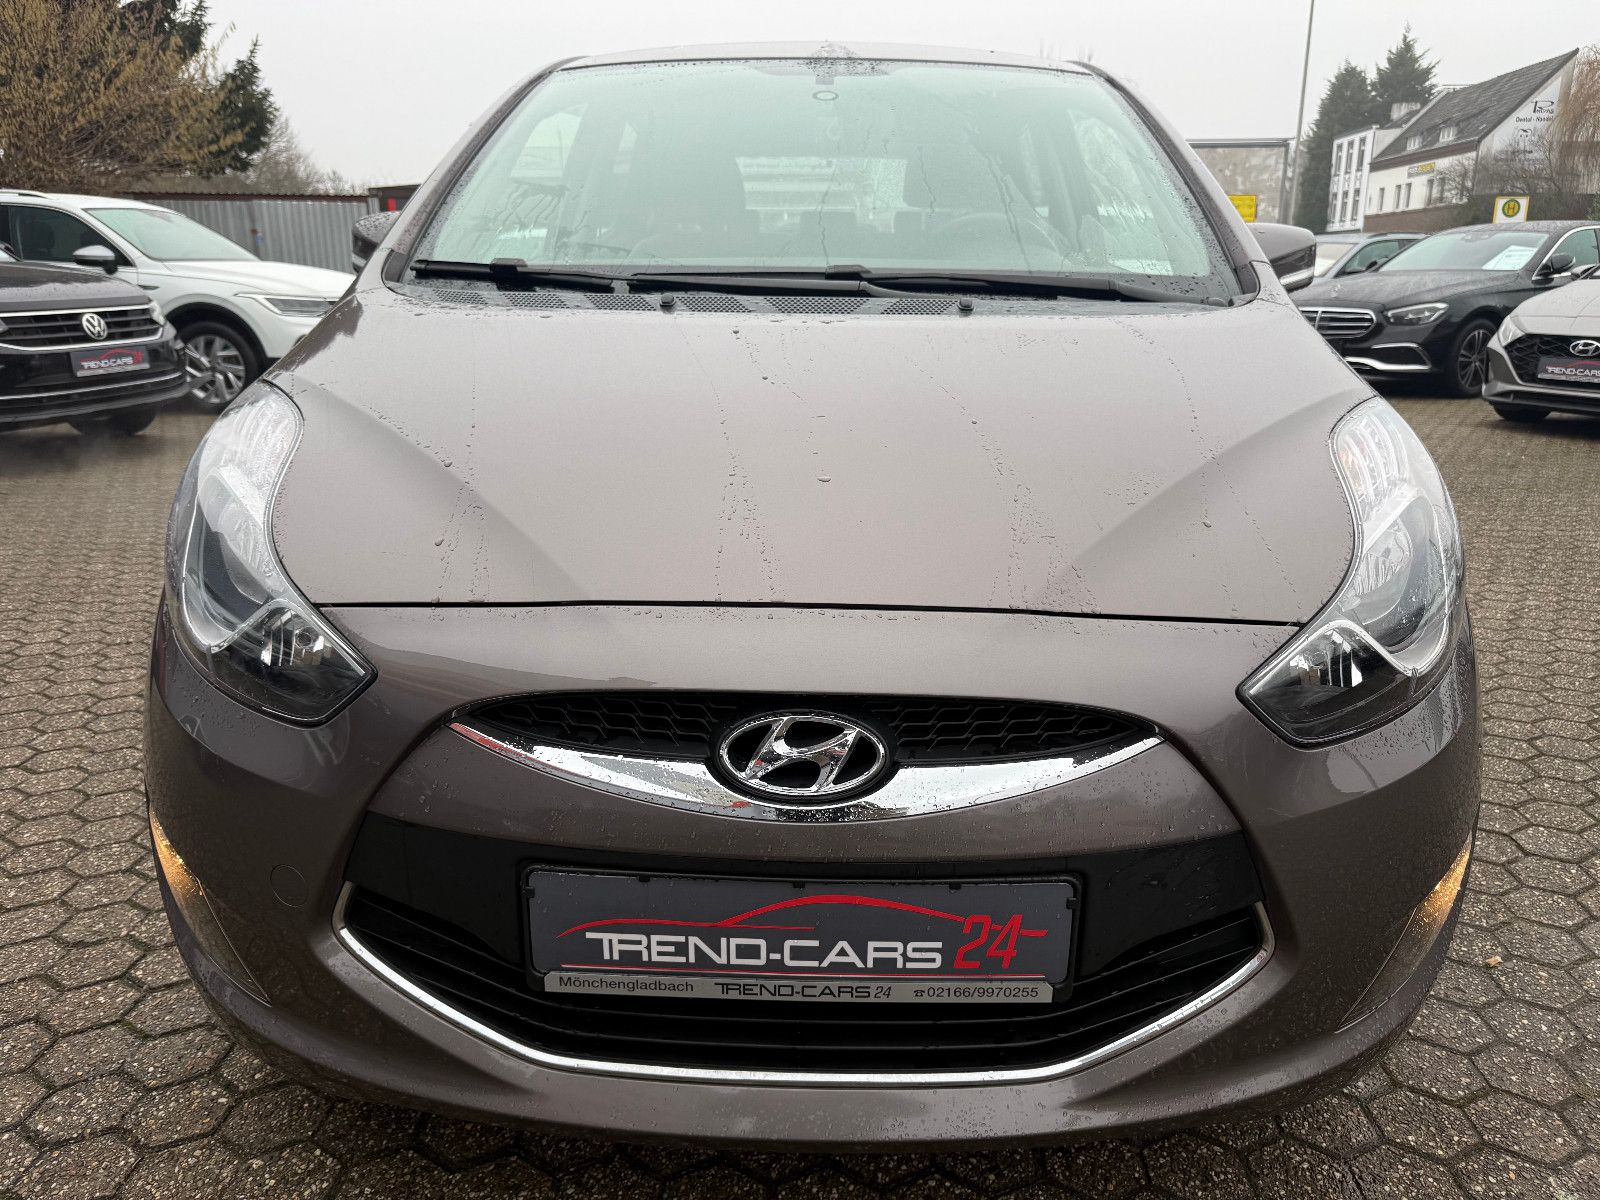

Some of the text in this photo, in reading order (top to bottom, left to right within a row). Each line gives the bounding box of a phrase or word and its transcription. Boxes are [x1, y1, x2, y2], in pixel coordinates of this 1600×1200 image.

[585, 914, 1023, 969] TREND-CARS 24
[558, 975, 1039, 999] Mönchengladbach TREND-CARS 24 02166/9970255
